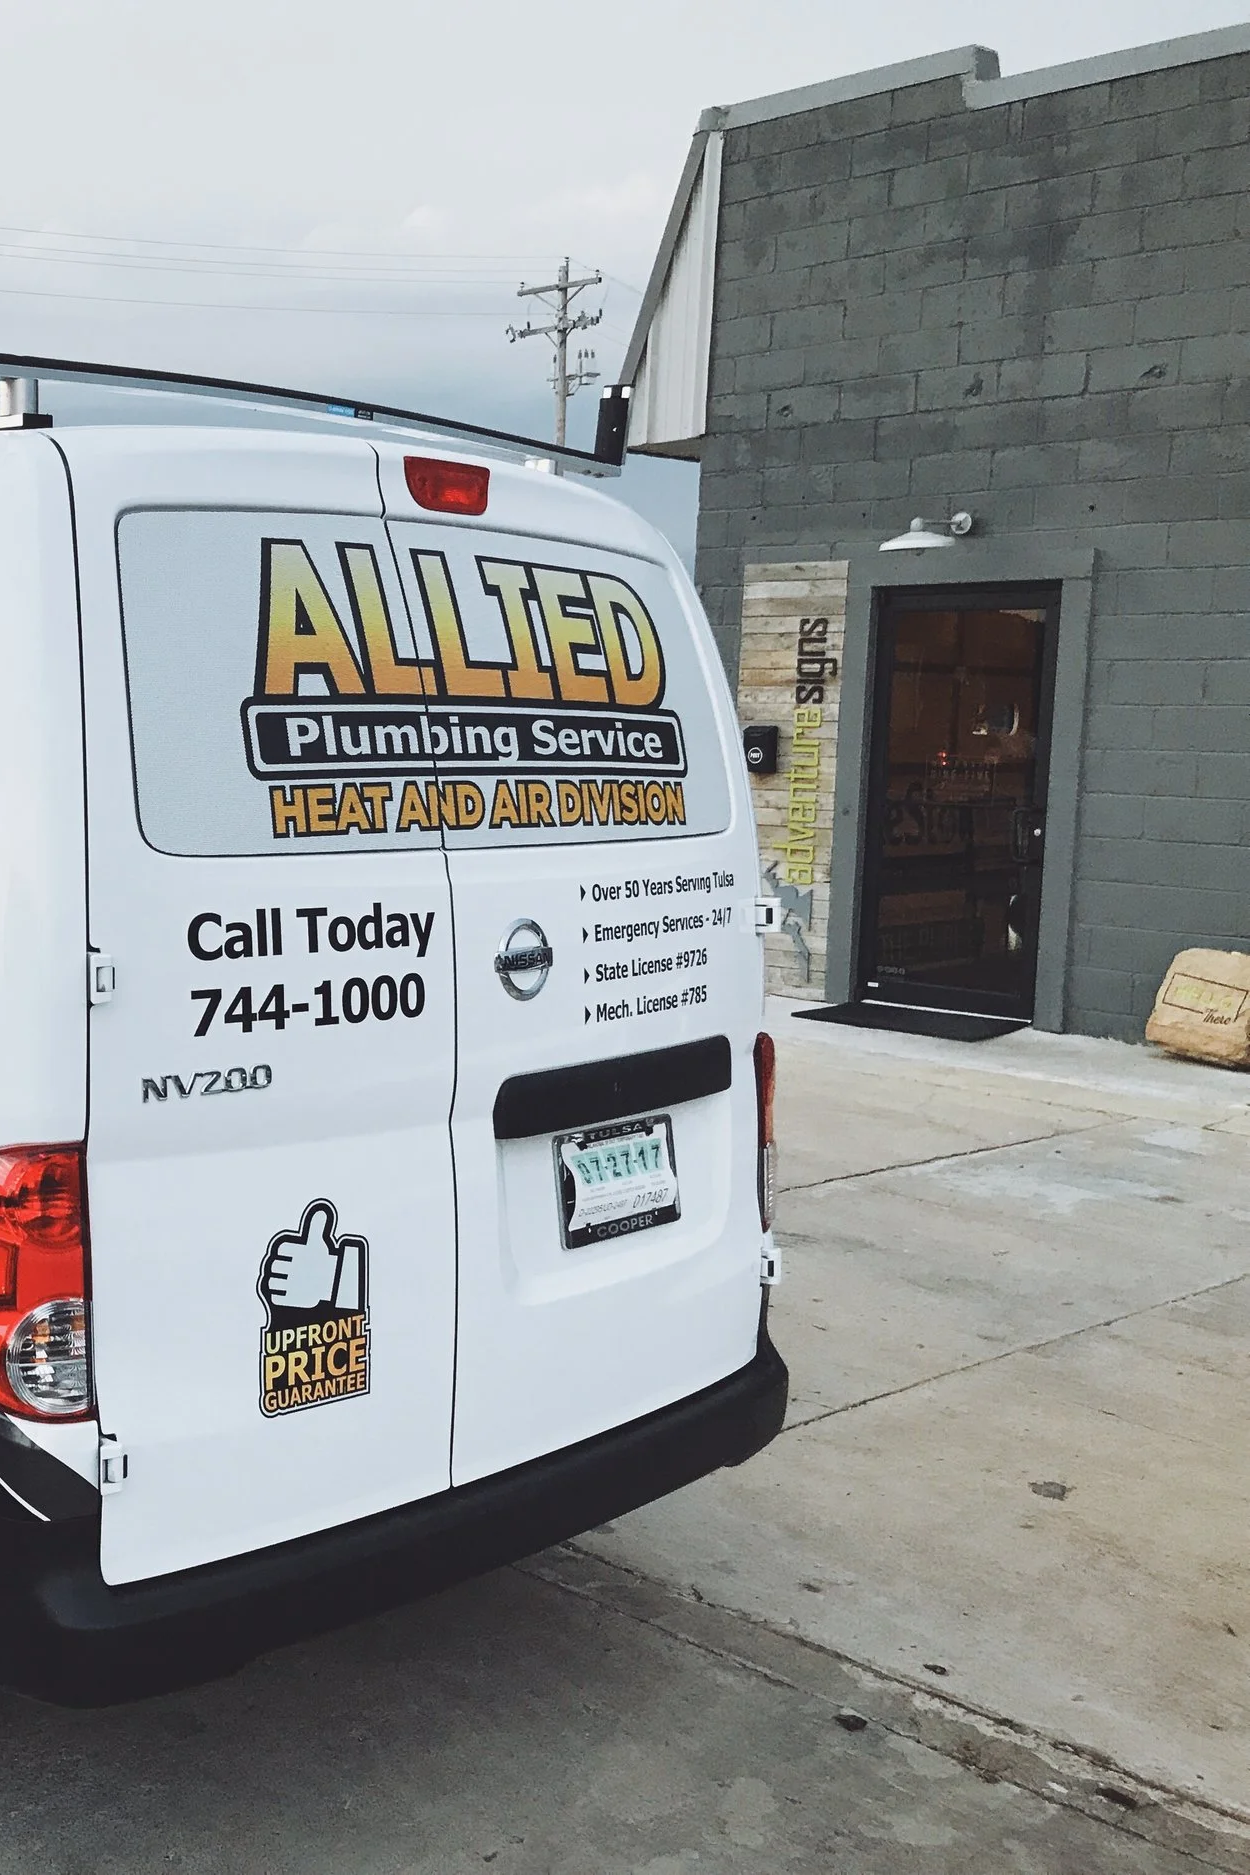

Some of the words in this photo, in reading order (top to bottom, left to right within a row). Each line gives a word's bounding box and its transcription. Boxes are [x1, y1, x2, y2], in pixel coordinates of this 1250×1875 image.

[253, 537, 666, 709] ALLIED
[795, 617, 838, 705] signs
[285, 715, 520, 762] Plumbing
[533, 719, 664, 760] Service
[269, 784, 393, 838] HEAT
[396, 781, 485, 833] AND
[489, 779, 557, 829] AIR
[555, 779, 687, 826] DIVISION
[774, 707, 823, 885] adventure
[592, 883, 621, 902] Over
[625, 880, 639, 899] 50
[642, 879, 673, 897] Years
[675, 875, 711, 893] Serving
[712, 870, 734, 889] Tulsa
[187, 907, 283, 961] Call
[296, 902, 435, 957] Today
[594, 918, 659, 943] Emergency
[662, 913, 704, 934] Services
[712, 907, 732, 927] 24/7
[503, 951, 550, 968] NISSAN
[595, 961, 628, 983] State
[631, 955, 673, 977] License
[675, 948, 708, 969] #9726
[190, 972, 426, 1037] 744-1000
[596, 1000, 633, 1023] Mech.
[636, 992, 678, 1015] License
[680, 984, 708, 1006] #785
[141, 1064, 274, 1103] NV200
[588, 1122, 643, 1140] TULSA
[596, 1214, 654, 1238] COOPER
[265, 1314, 365, 1354] UPFRONT
[265, 1337, 367, 1390] PRICE
[264, 1371, 365, 1411] GUARANTEE
